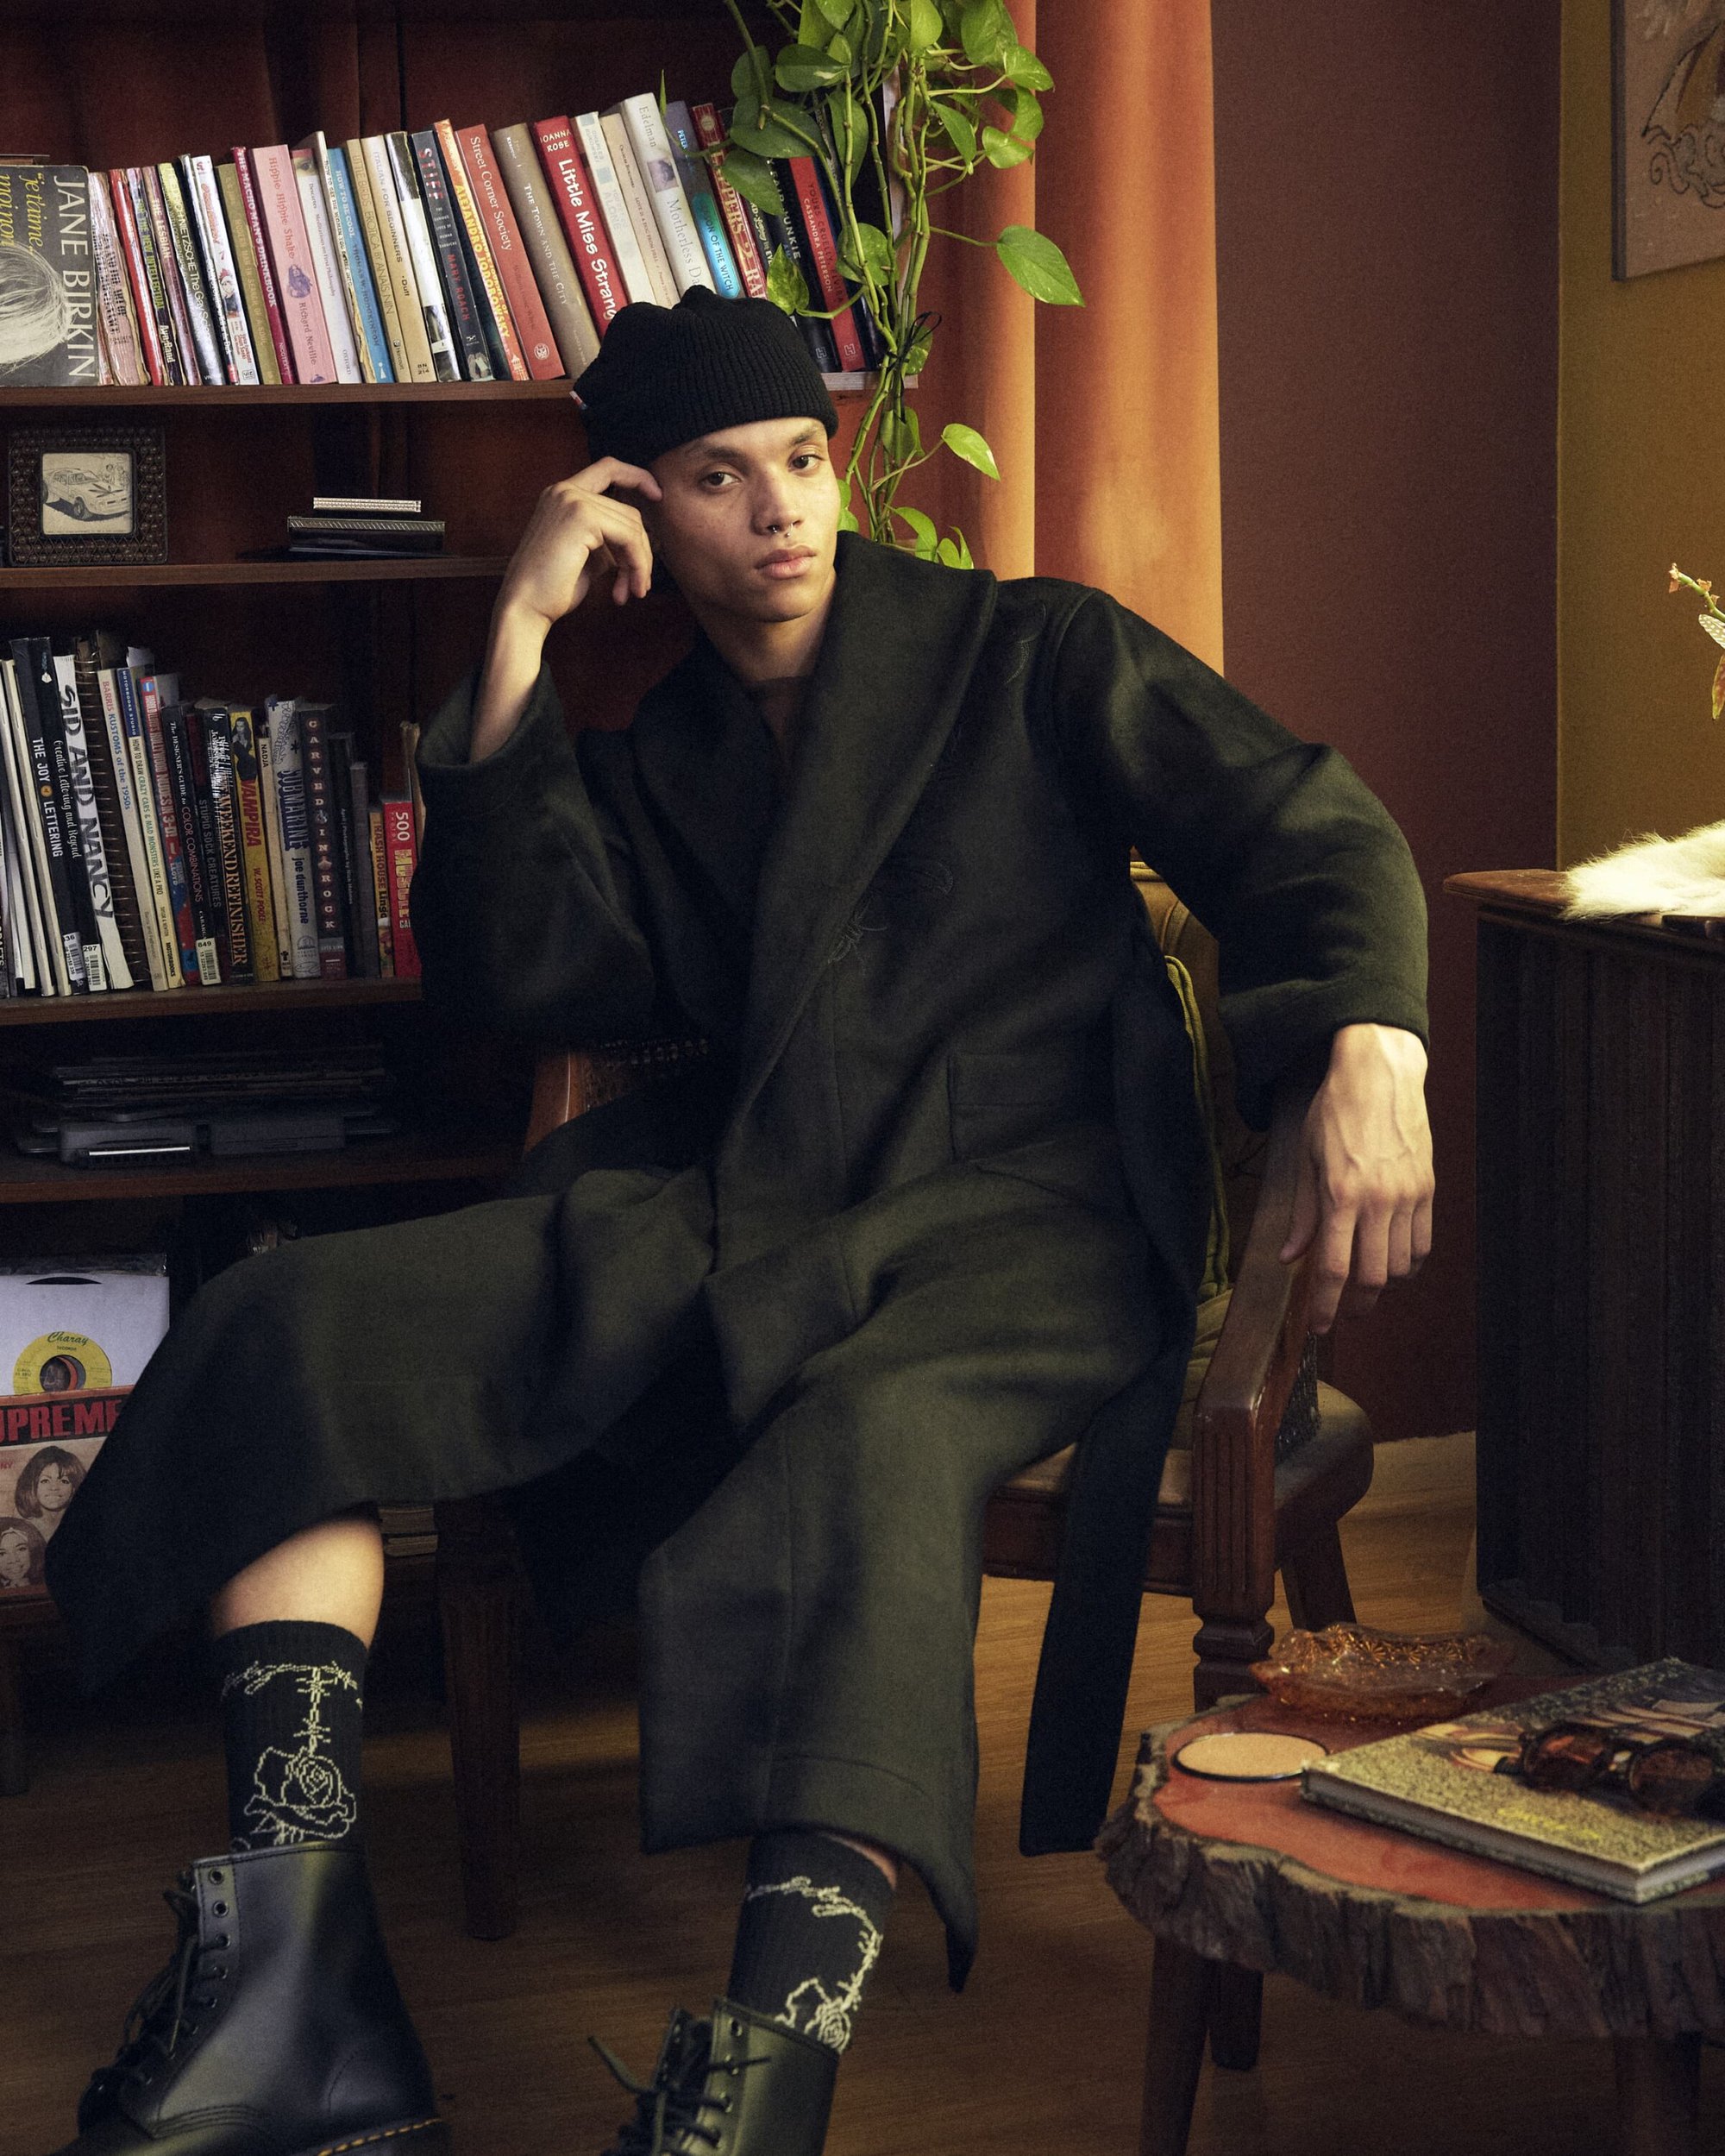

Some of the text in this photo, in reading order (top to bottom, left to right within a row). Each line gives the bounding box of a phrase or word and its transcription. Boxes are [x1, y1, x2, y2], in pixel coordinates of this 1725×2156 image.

[547, 140, 570, 153] ROSE
[638, 104, 659, 148] Edelman
[352, 154, 365, 179] LITTLE
[417, 147, 443, 201] STIFF
[0, 173, 19, 247] moi non
[267, 156, 296, 259] Hippie Hippie Shake
[335, 169, 354, 238] HOW TO BE COOL
[357, 179, 371, 206] BIRDS
[373, 151, 403, 262] ITALIAN FOR BEGINNERS
[469, 135, 488, 169] Street
[480, 168, 501, 209] Corner
[491, 210, 514, 252] Society
[602, 190, 622, 232] ALONE
[138, 217, 148, 231] THE
[141, 233, 153, 251] NEW
[151, 198, 172, 258] THE LESBIAN
[177, 217, 197, 270] NIETZSCHE
[236, 150, 276, 306] THE MACHO MAN'S DRINKBOOK
[308, 183, 317, 209] Descartes
[315, 213, 325, 245] Meditations
[324, 267, 336, 297] Philosophy
[333, 212, 342, 236] WOMEN
[364, 211, 380, 249] EROTICA
[523, 183, 568, 305] THE TOWN AND THE CITY
[557, 157, 619, 321] Little Miss Strang
[666, 198, 698, 264] Motherless
[709, 234, 719, 247] OF
[803, 198, 832, 292] CASSANDRA PETERSON
[807, 183, 822, 215] YOURS
[817, 220, 835, 265] CRUELLY,
[53, 175, 97, 378] JANE BIRKIN
[351, 244, 364, 279] THOMAS
[359, 279, 367, 290] W.
[373, 250, 383, 261] BY
[455, 183, 483, 253] ALEJANDRO
[476, 255, 510, 339] JODOROWSKY
[713, 247, 724, 263] THE
[718, 264, 733, 291] WITCH
[145, 255, 164, 309] INTELLECTUAL
[189, 270, 201, 290] The
[193, 290, 205, 309] Gay
[234, 218, 246, 248] MODERN
[241, 249, 249, 265] MAN
[247, 277, 259, 305] SEARCH
[257, 325, 267, 345] SOUL
[401, 279, 410, 297] Duff
[447, 253, 470, 321] MARY ROACH
[382, 293, 394, 314] NIN
[158, 323, 175, 362] Ayn Rand
[278, 342, 289, 369] NICOTEXT
[297, 301, 318, 365] Richard Neville
[342, 349, 351, 374] OXFORD
[395, 348, 404, 370] Harcourt
[144, 695, 156, 713] HAROLD
[102, 680, 131, 809] BARRIS KUSTOMS of the 1950s
[131, 739, 140, 752] HOW
[149, 731, 167, 773] HOLLYWOOD
[135, 760, 144, 776] DRAW
[137, 776, 147, 795] CRAZY
[156, 773, 172, 806] NUDES
[32, 737, 63, 858] THE JOY LETTERING
[53, 739, 82, 858] Creative Lettering and Beyond
[58, 683, 114, 921] SID AND NANCY
[141, 796, 149, 812] CARS
[161, 805, 173, 814] IN
[169, 721, 204, 903] The DESIGNER'S GUIDE to COLOR COMBINATIONS
[240, 777, 261, 846] VAMPIRA
[280, 768, 310, 849] SUBMARINE
[163, 815, 177, 838] 3-D!
[217, 794, 237, 871] WEEKEND
[308, 720, 325, 807] CARVED
[321, 873, 336, 930] ROCK
[395, 811, 410, 841] 500
[147, 835, 158, 867] MONSTERS
[198, 799, 223, 908] STUPID SOCK CREATURES
[375, 854, 386, 889] HOUSE
[253, 867, 266, 921] W. SCOTT POOLE
[292, 856, 310, 924] joe dunthorne
[394, 848, 411, 917] MUSCLE
[224, 871, 248, 965] REFINISHER
[165, 941, 175, 977] MOTORBOOKS
[47, 1331, 90, 1347] Charay
